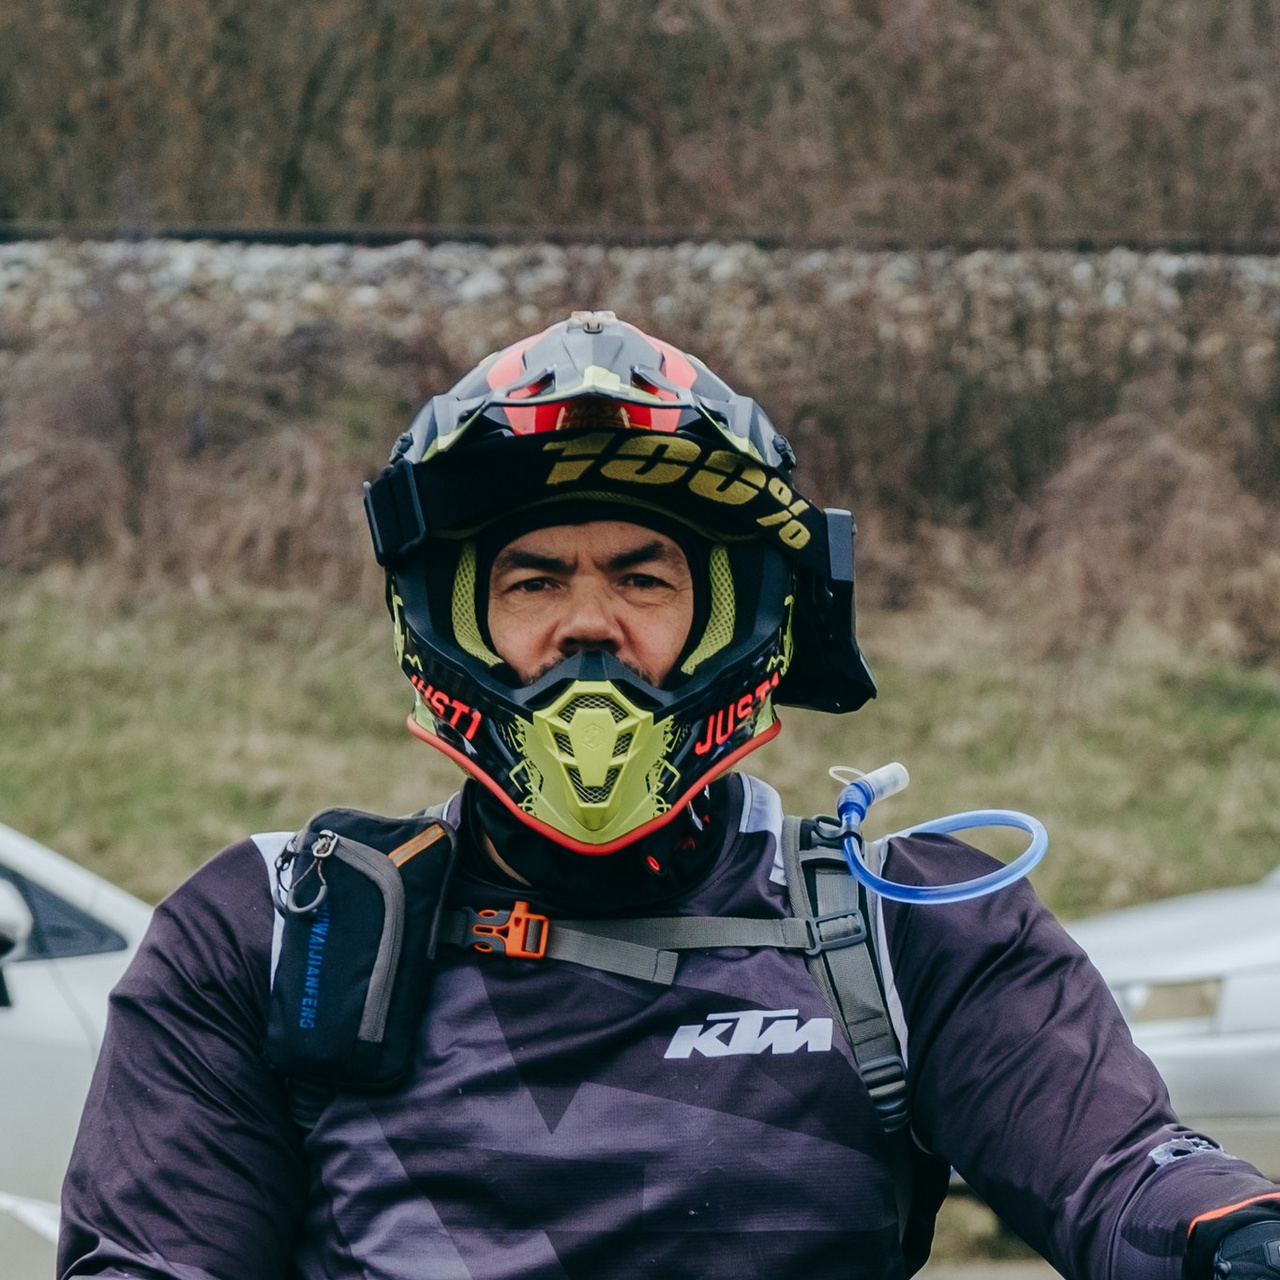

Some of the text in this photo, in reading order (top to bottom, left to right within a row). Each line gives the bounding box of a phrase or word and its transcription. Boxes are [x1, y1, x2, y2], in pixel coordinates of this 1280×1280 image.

[543, 432, 811, 549] 100%
[411, 674, 482, 741] ST1
[664, 1009, 834, 1059] KTM
